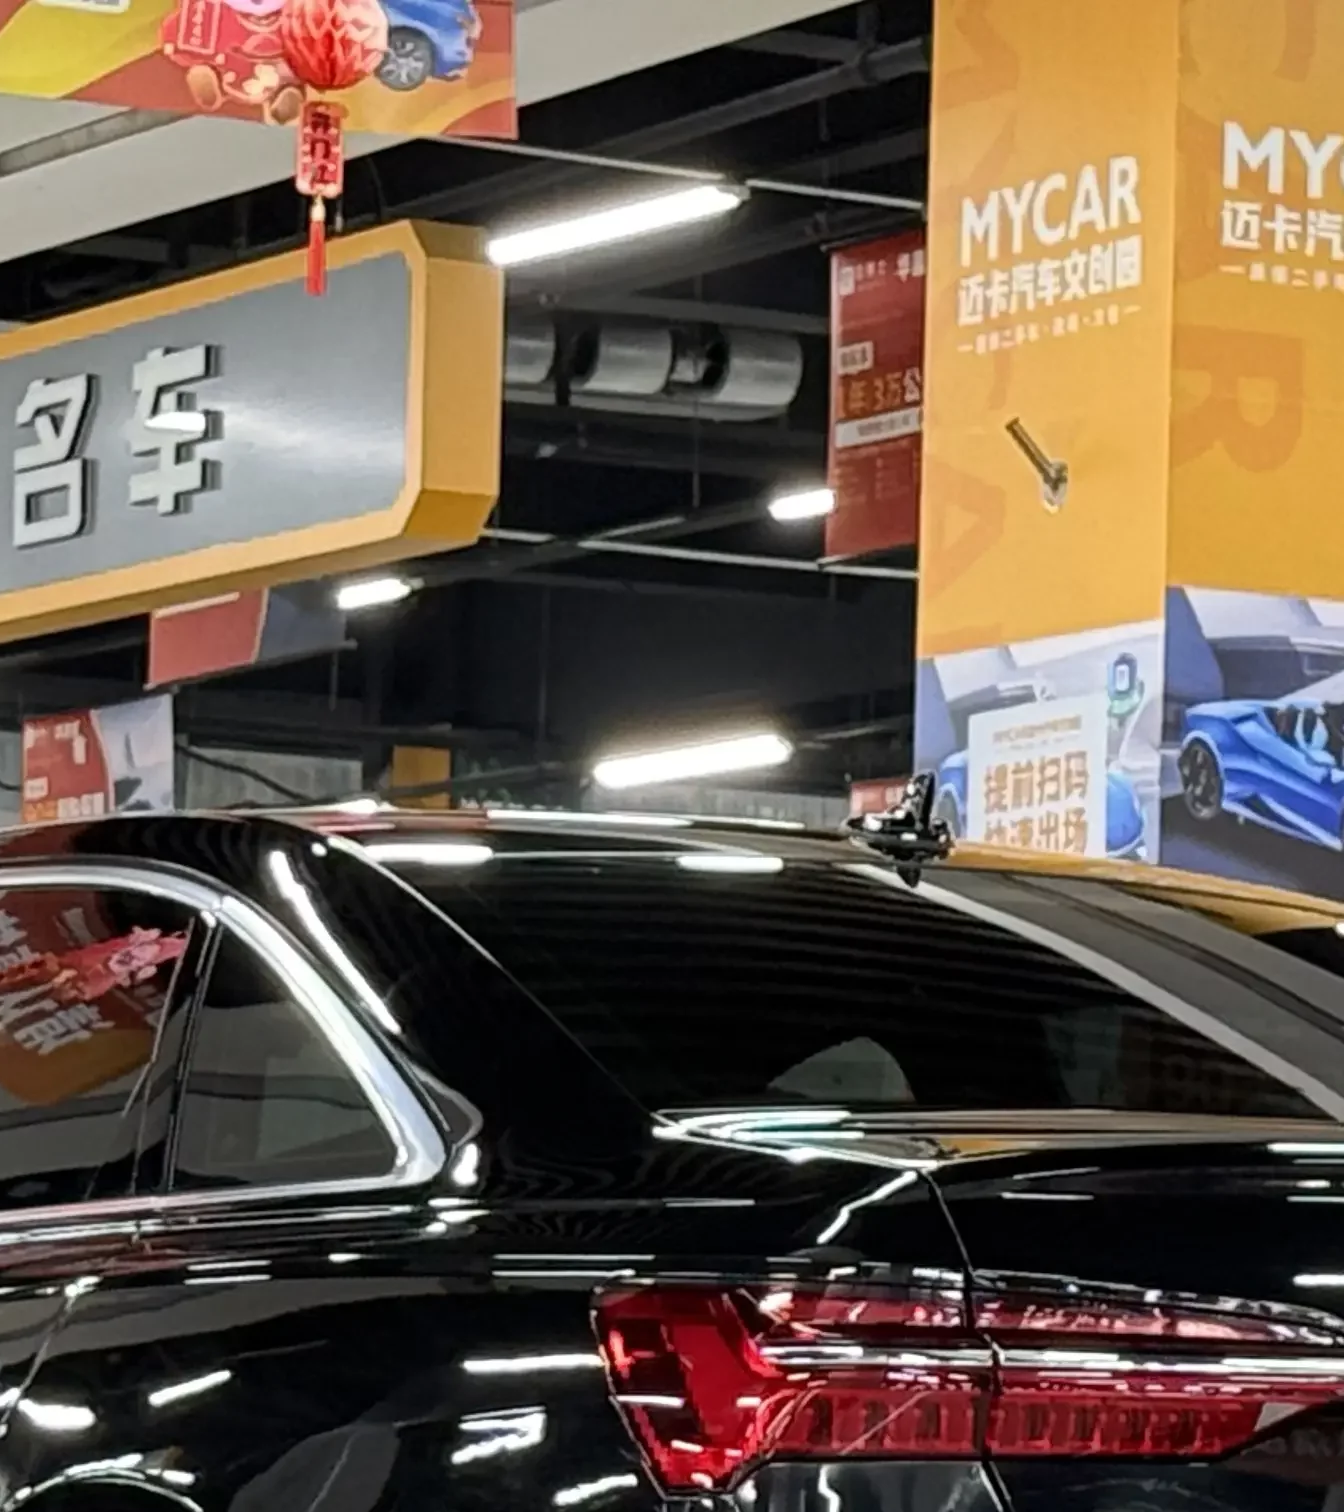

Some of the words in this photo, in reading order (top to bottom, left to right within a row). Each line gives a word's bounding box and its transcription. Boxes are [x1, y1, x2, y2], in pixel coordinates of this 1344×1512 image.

[960, 155, 1143, 268] MYCAR
[958, 234, 1142, 328] 迈卡汽车文创园
[984, 751, 1089, 814] 提前扫码
